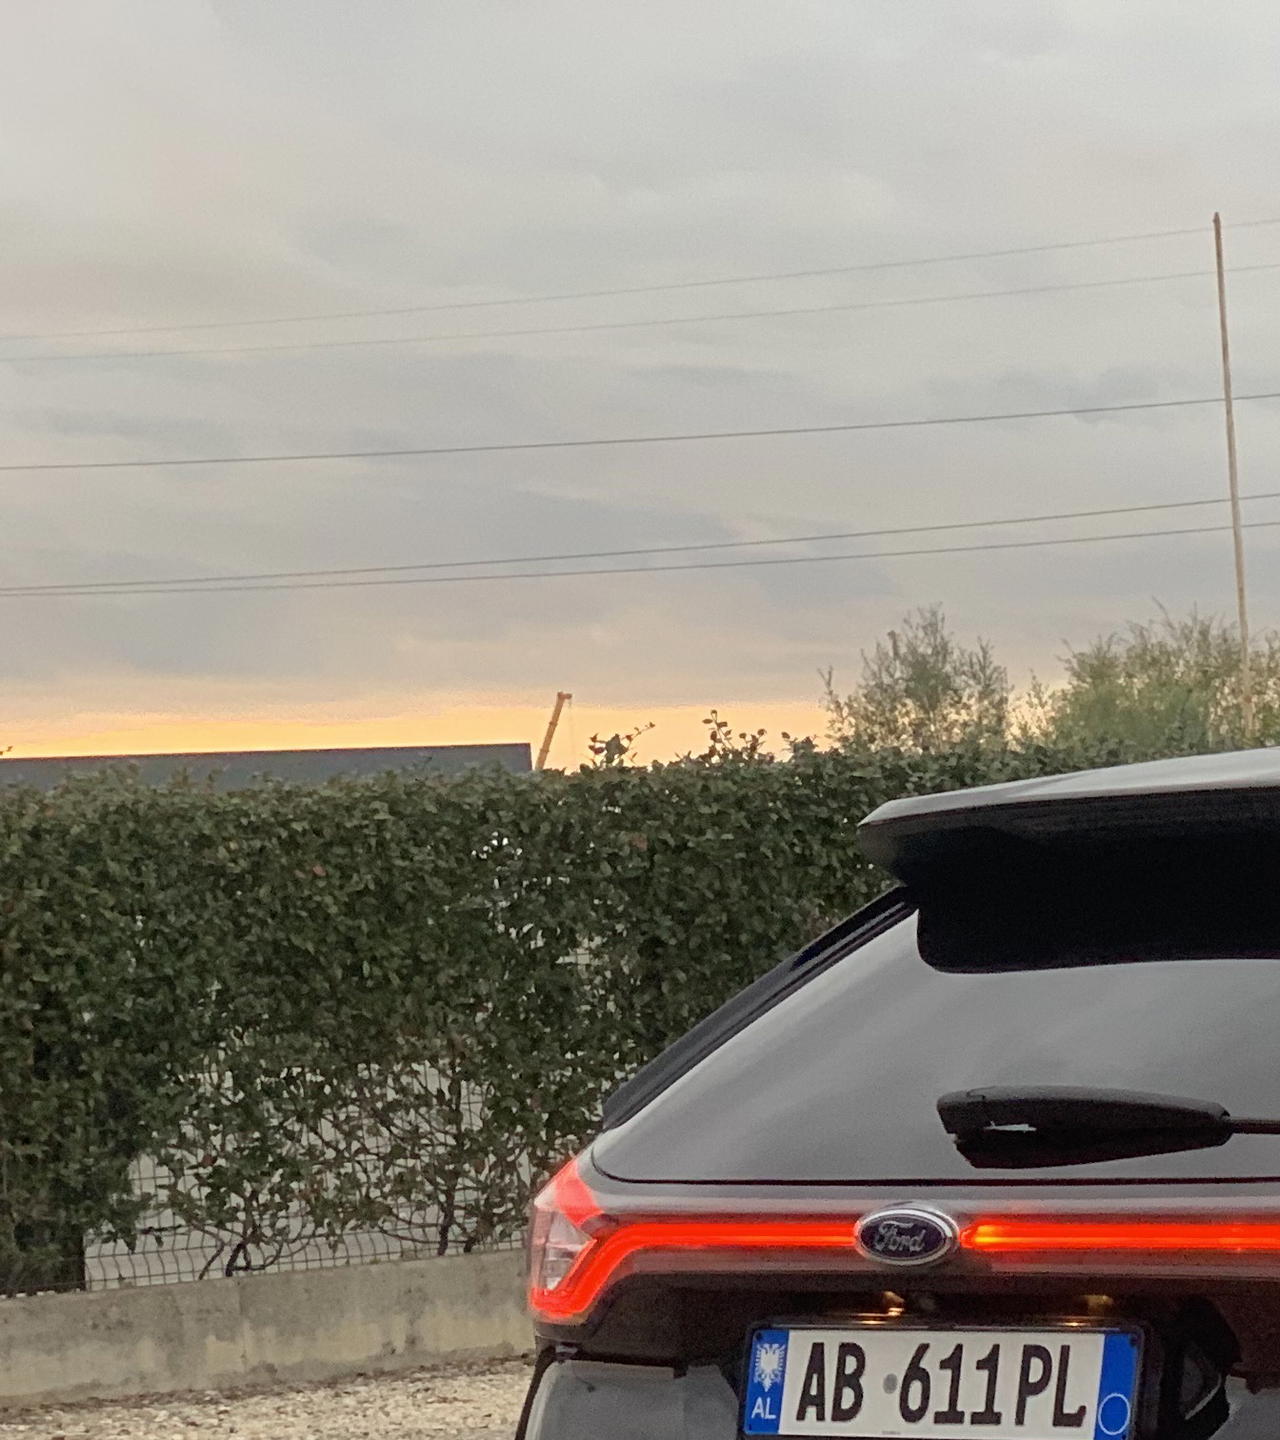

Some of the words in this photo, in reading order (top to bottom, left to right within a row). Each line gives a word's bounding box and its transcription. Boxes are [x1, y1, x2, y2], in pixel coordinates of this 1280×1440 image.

[874, 1220, 927, 1252] Ford
[796, 1341, 866, 1422] AB
[751, 1396, 777, 1420] AL
